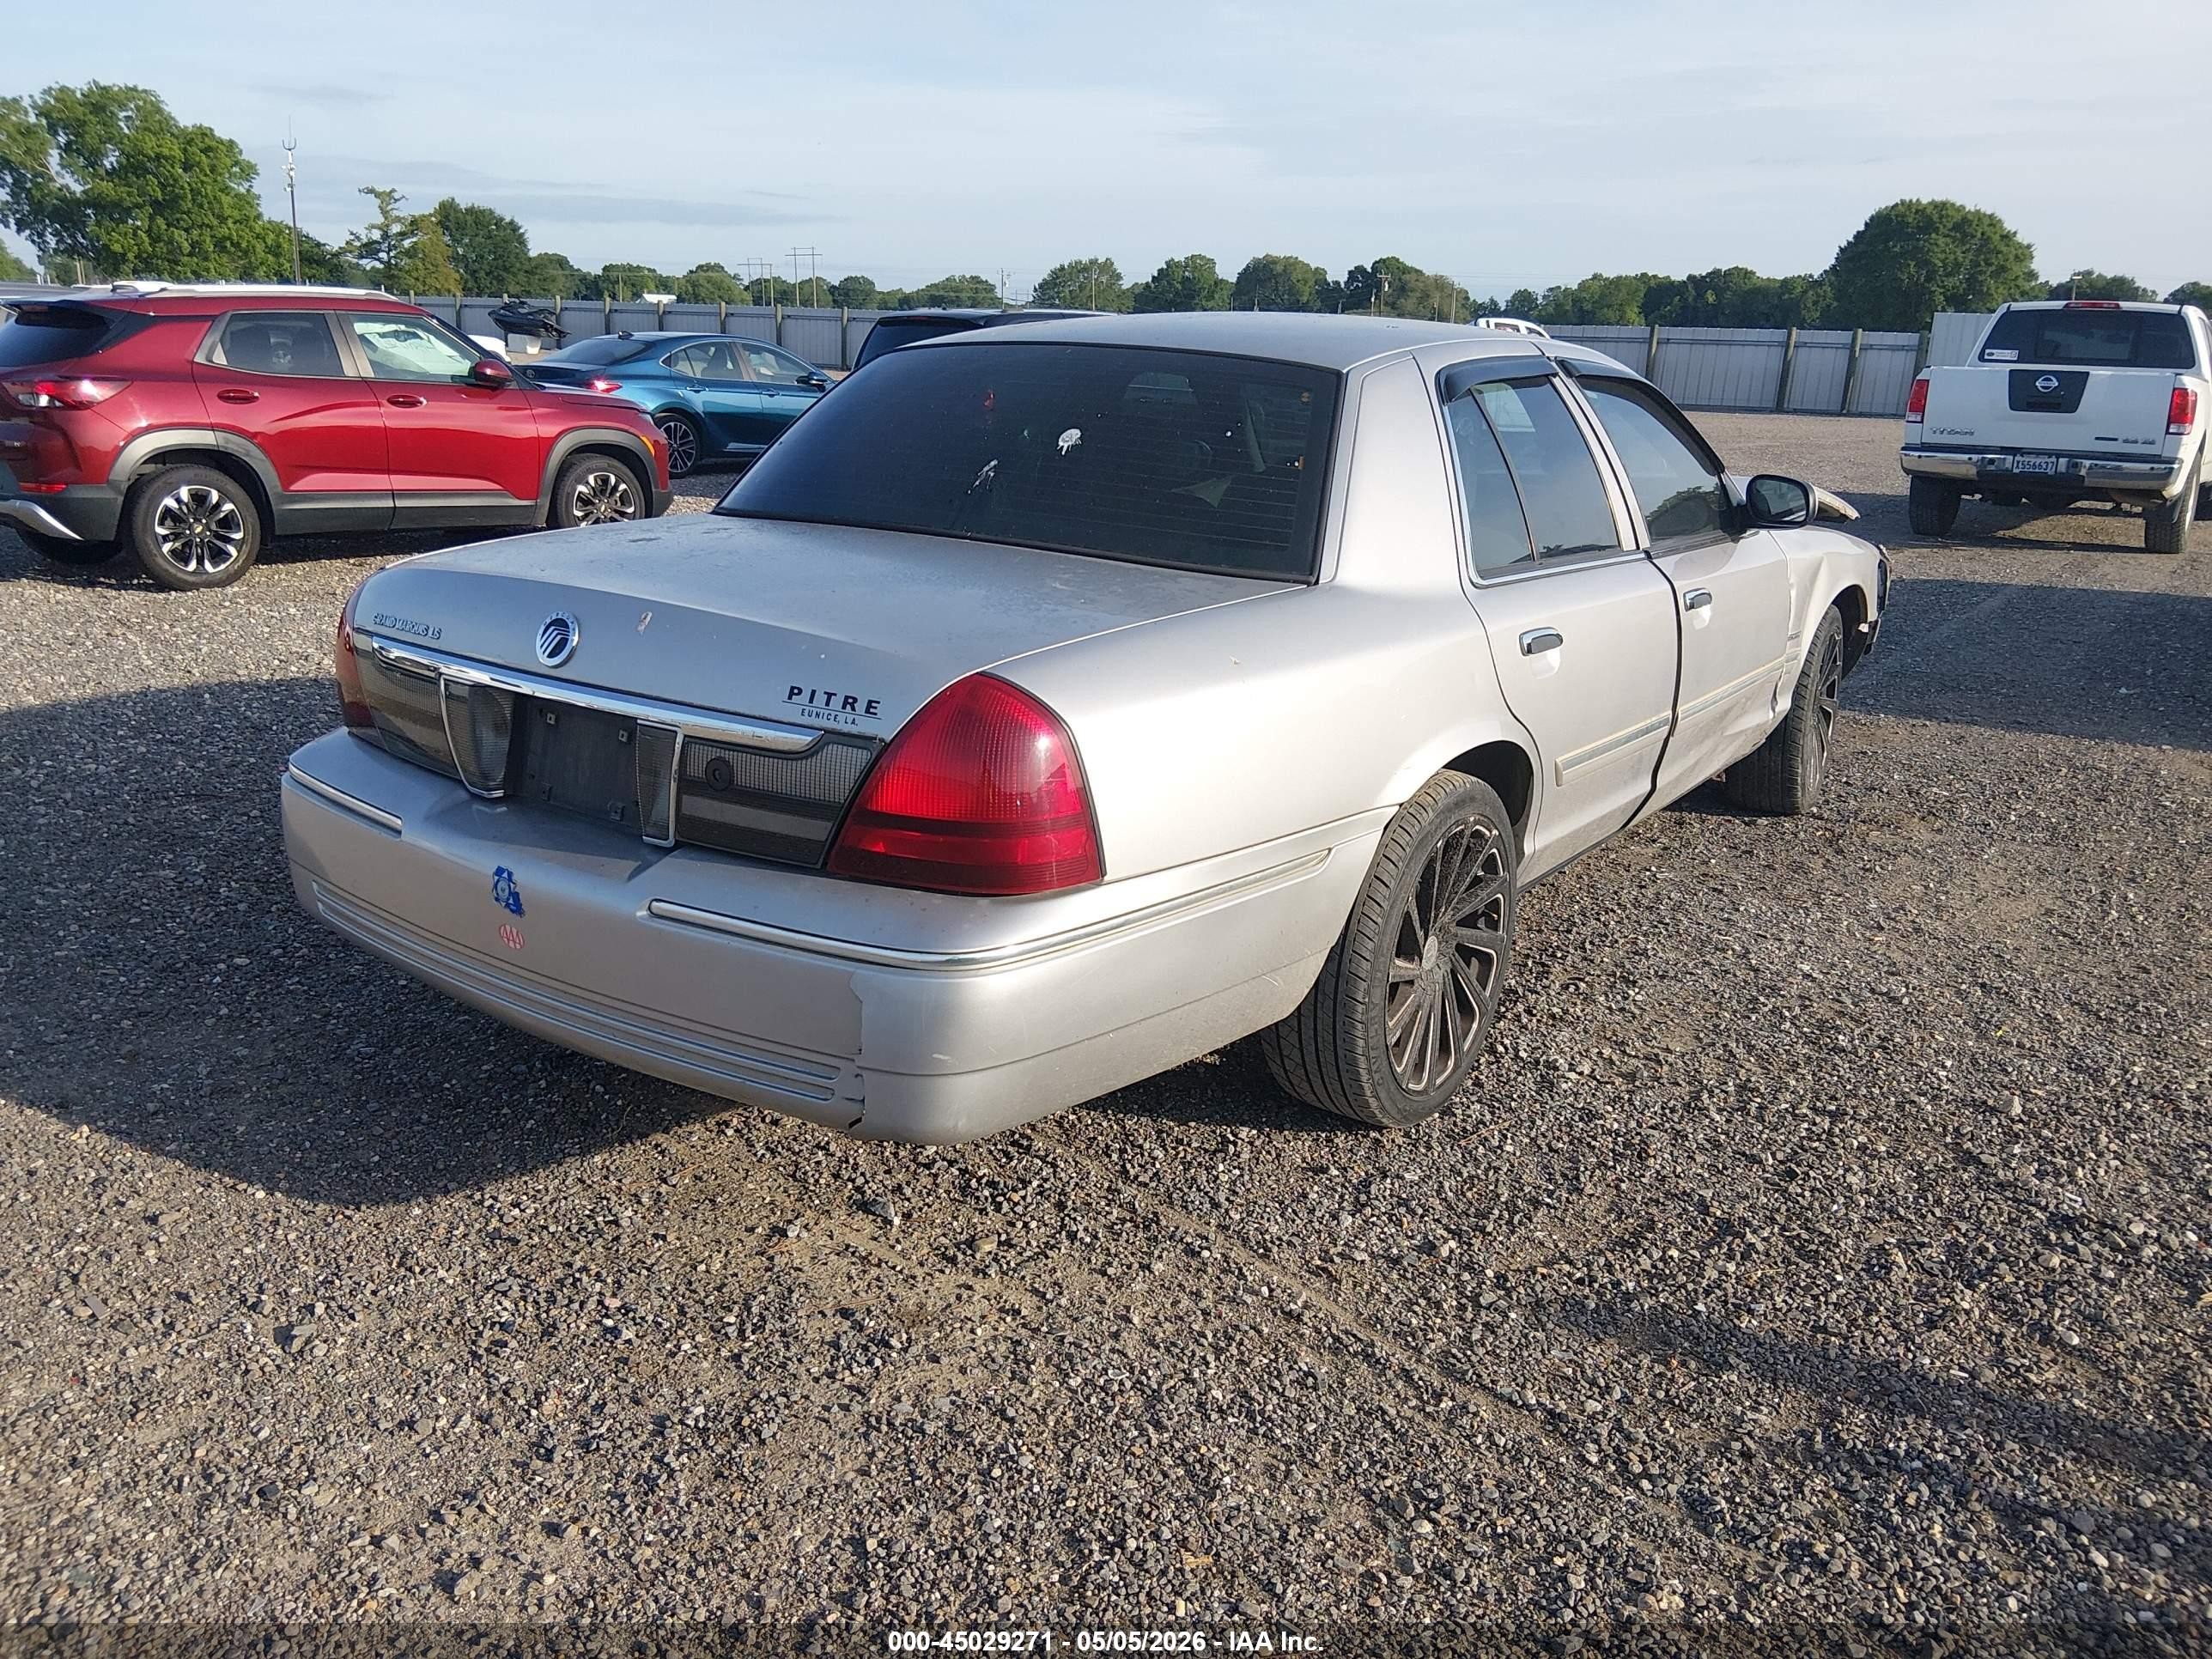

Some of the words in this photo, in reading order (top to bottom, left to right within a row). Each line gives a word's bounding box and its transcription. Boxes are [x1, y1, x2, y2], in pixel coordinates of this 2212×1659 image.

[1930, 427, 1974, 436] TITAN
[2015, 459, 2055, 471] X556637
[787, 685, 881, 715] PITRE
[800, 708, 840, 725] EUNICE,
[844, 715, 859, 726] LA.
